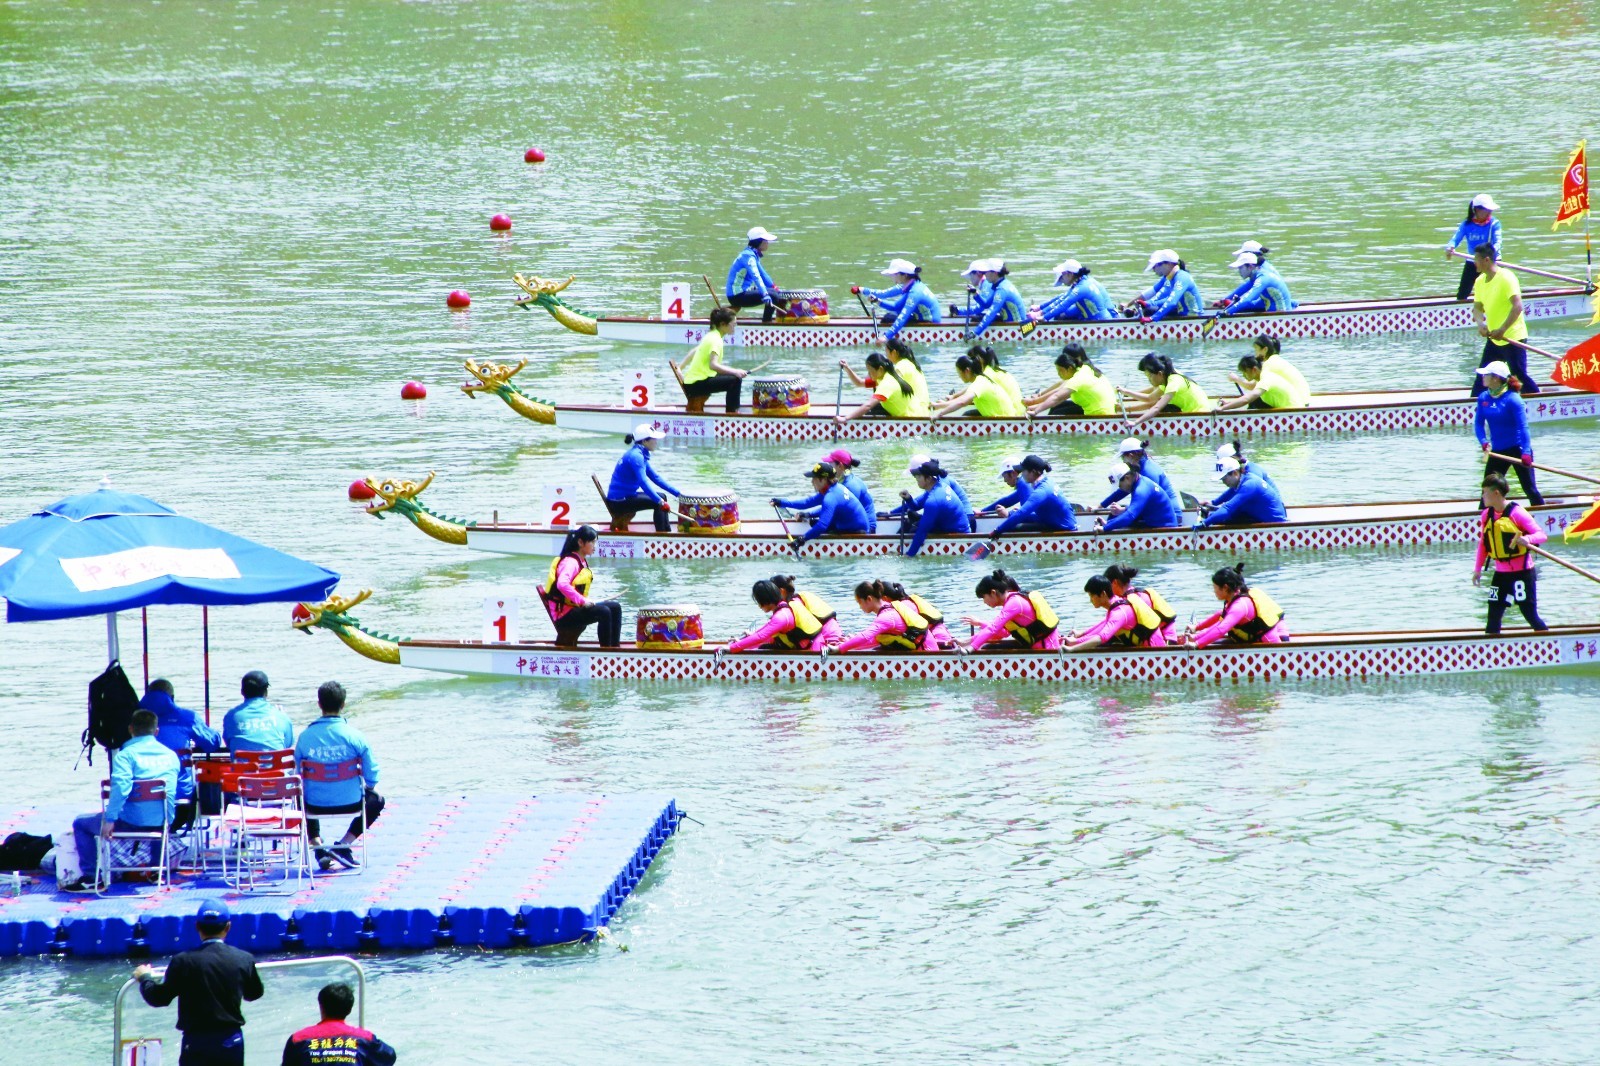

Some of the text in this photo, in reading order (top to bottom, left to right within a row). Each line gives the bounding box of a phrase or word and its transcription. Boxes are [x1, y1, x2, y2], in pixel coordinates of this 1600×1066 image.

[668, 298, 684, 318] 4
[631, 385, 648, 407] 3
[551, 501, 570, 525] 2
[1514, 580, 1527, 601] 8
[493, 615, 507, 641] 1
